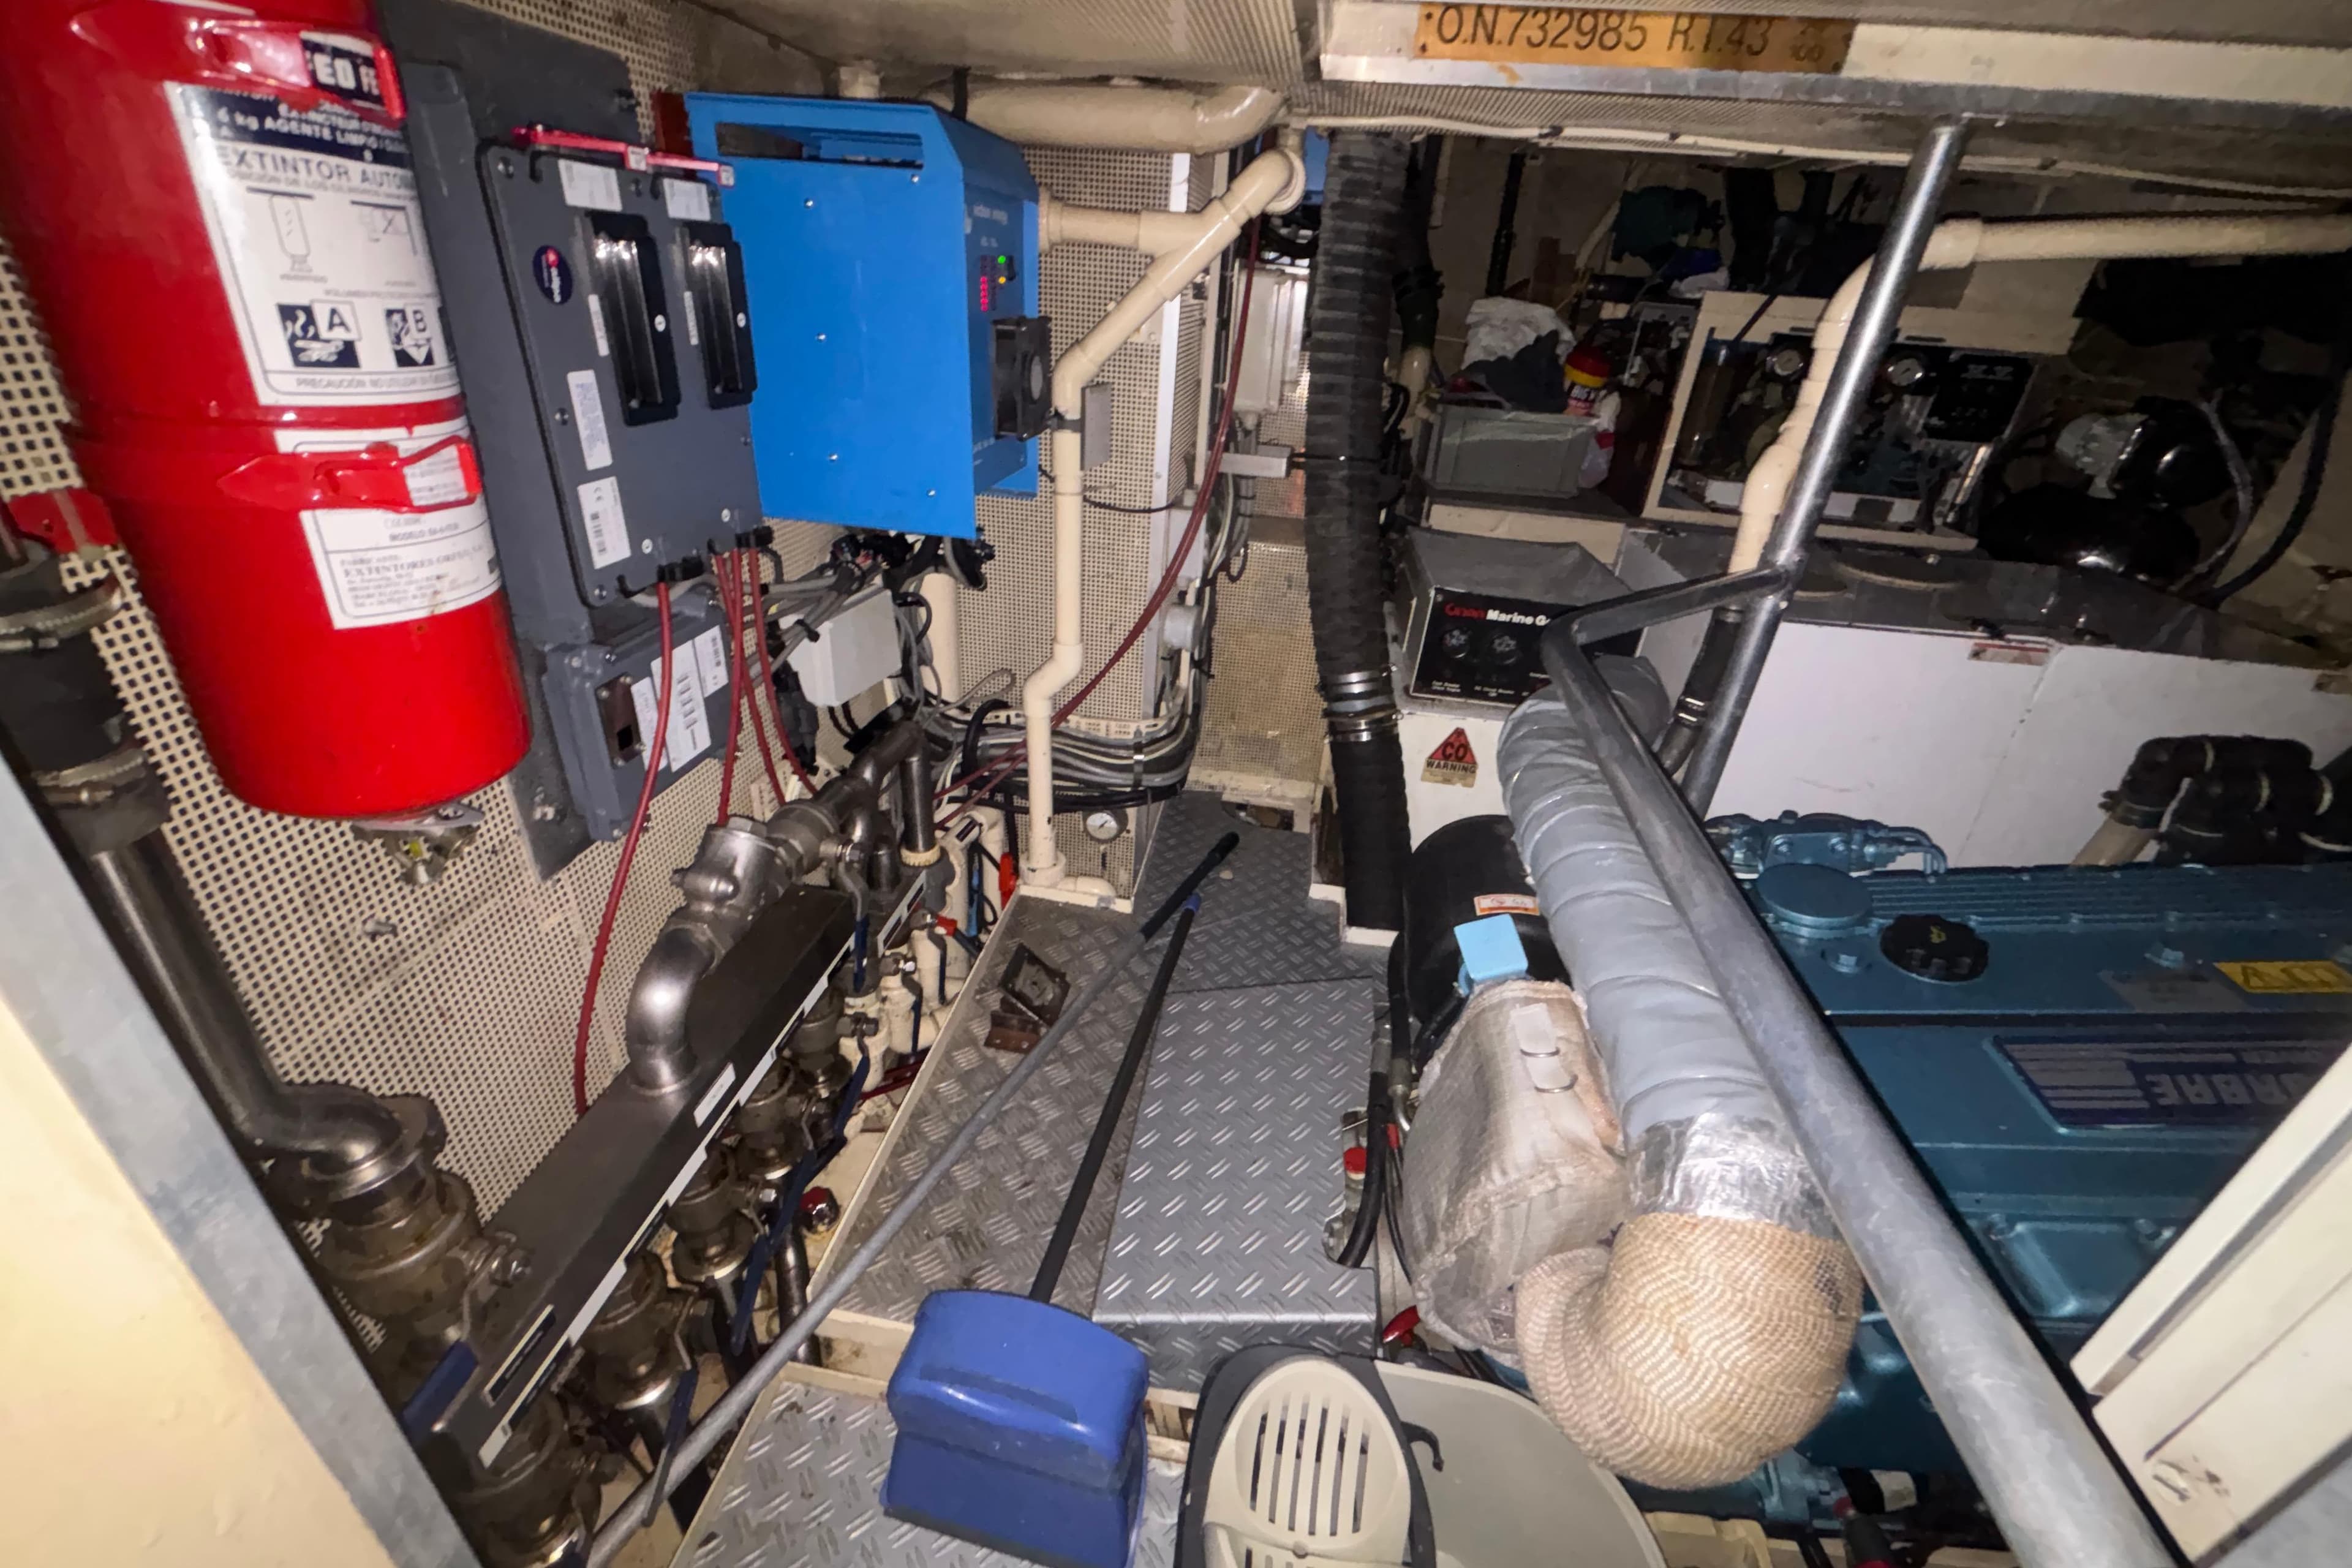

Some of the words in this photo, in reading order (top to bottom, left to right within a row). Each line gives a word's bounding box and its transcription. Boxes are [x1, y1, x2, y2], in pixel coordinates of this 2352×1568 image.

[264, 115, 333, 141] AGENTE
[217, 145, 350, 183] EXTINTOR
[327, 307, 350, 333] A
[413, 309, 428, 333] B
[1485, 608, 1534, 626] Marine
[1442, 742, 1468, 761] CO
[1426, 760, 1477, 774] WARNING
